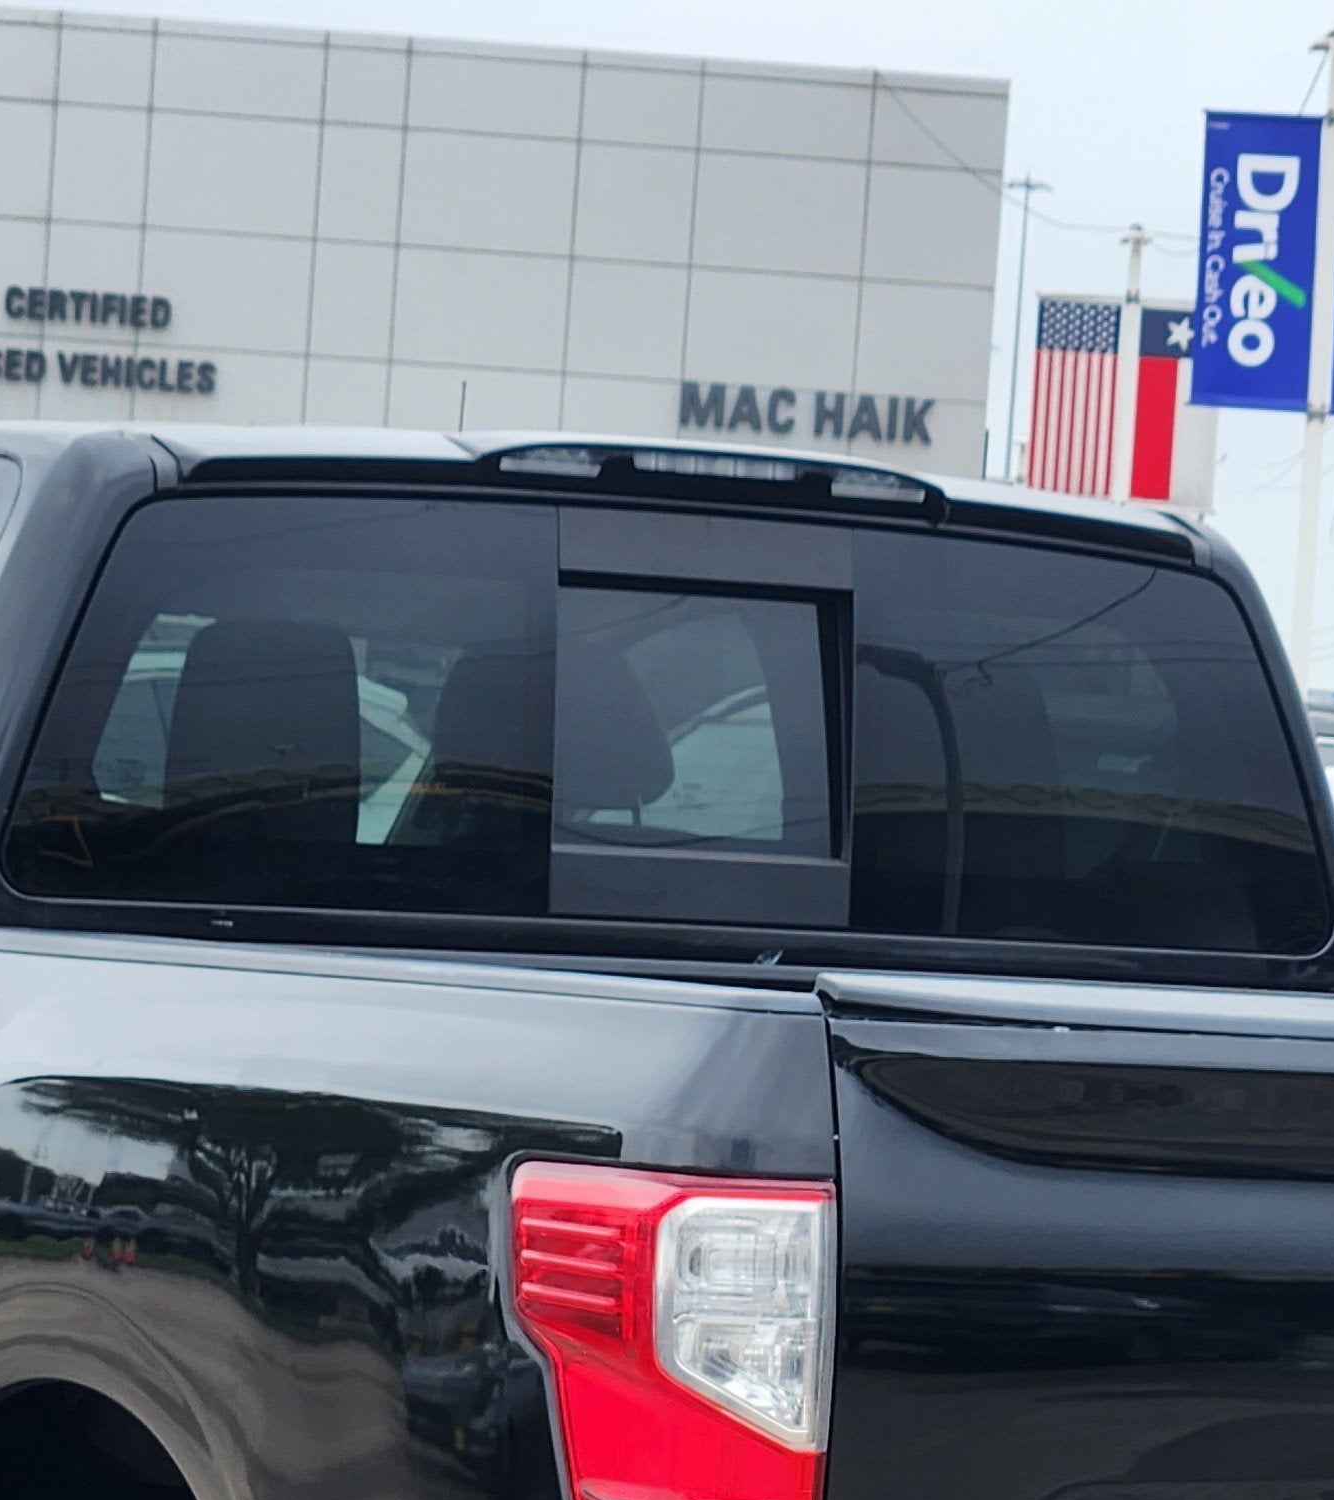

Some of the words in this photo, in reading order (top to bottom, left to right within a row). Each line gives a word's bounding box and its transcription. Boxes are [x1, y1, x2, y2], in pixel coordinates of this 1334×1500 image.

[5, 285, 172, 331] CERTIFIED
[57, 350, 216, 394] VEHICLES
[680, 380, 796, 434] MAC
[813, 390, 935, 446] HAIK
